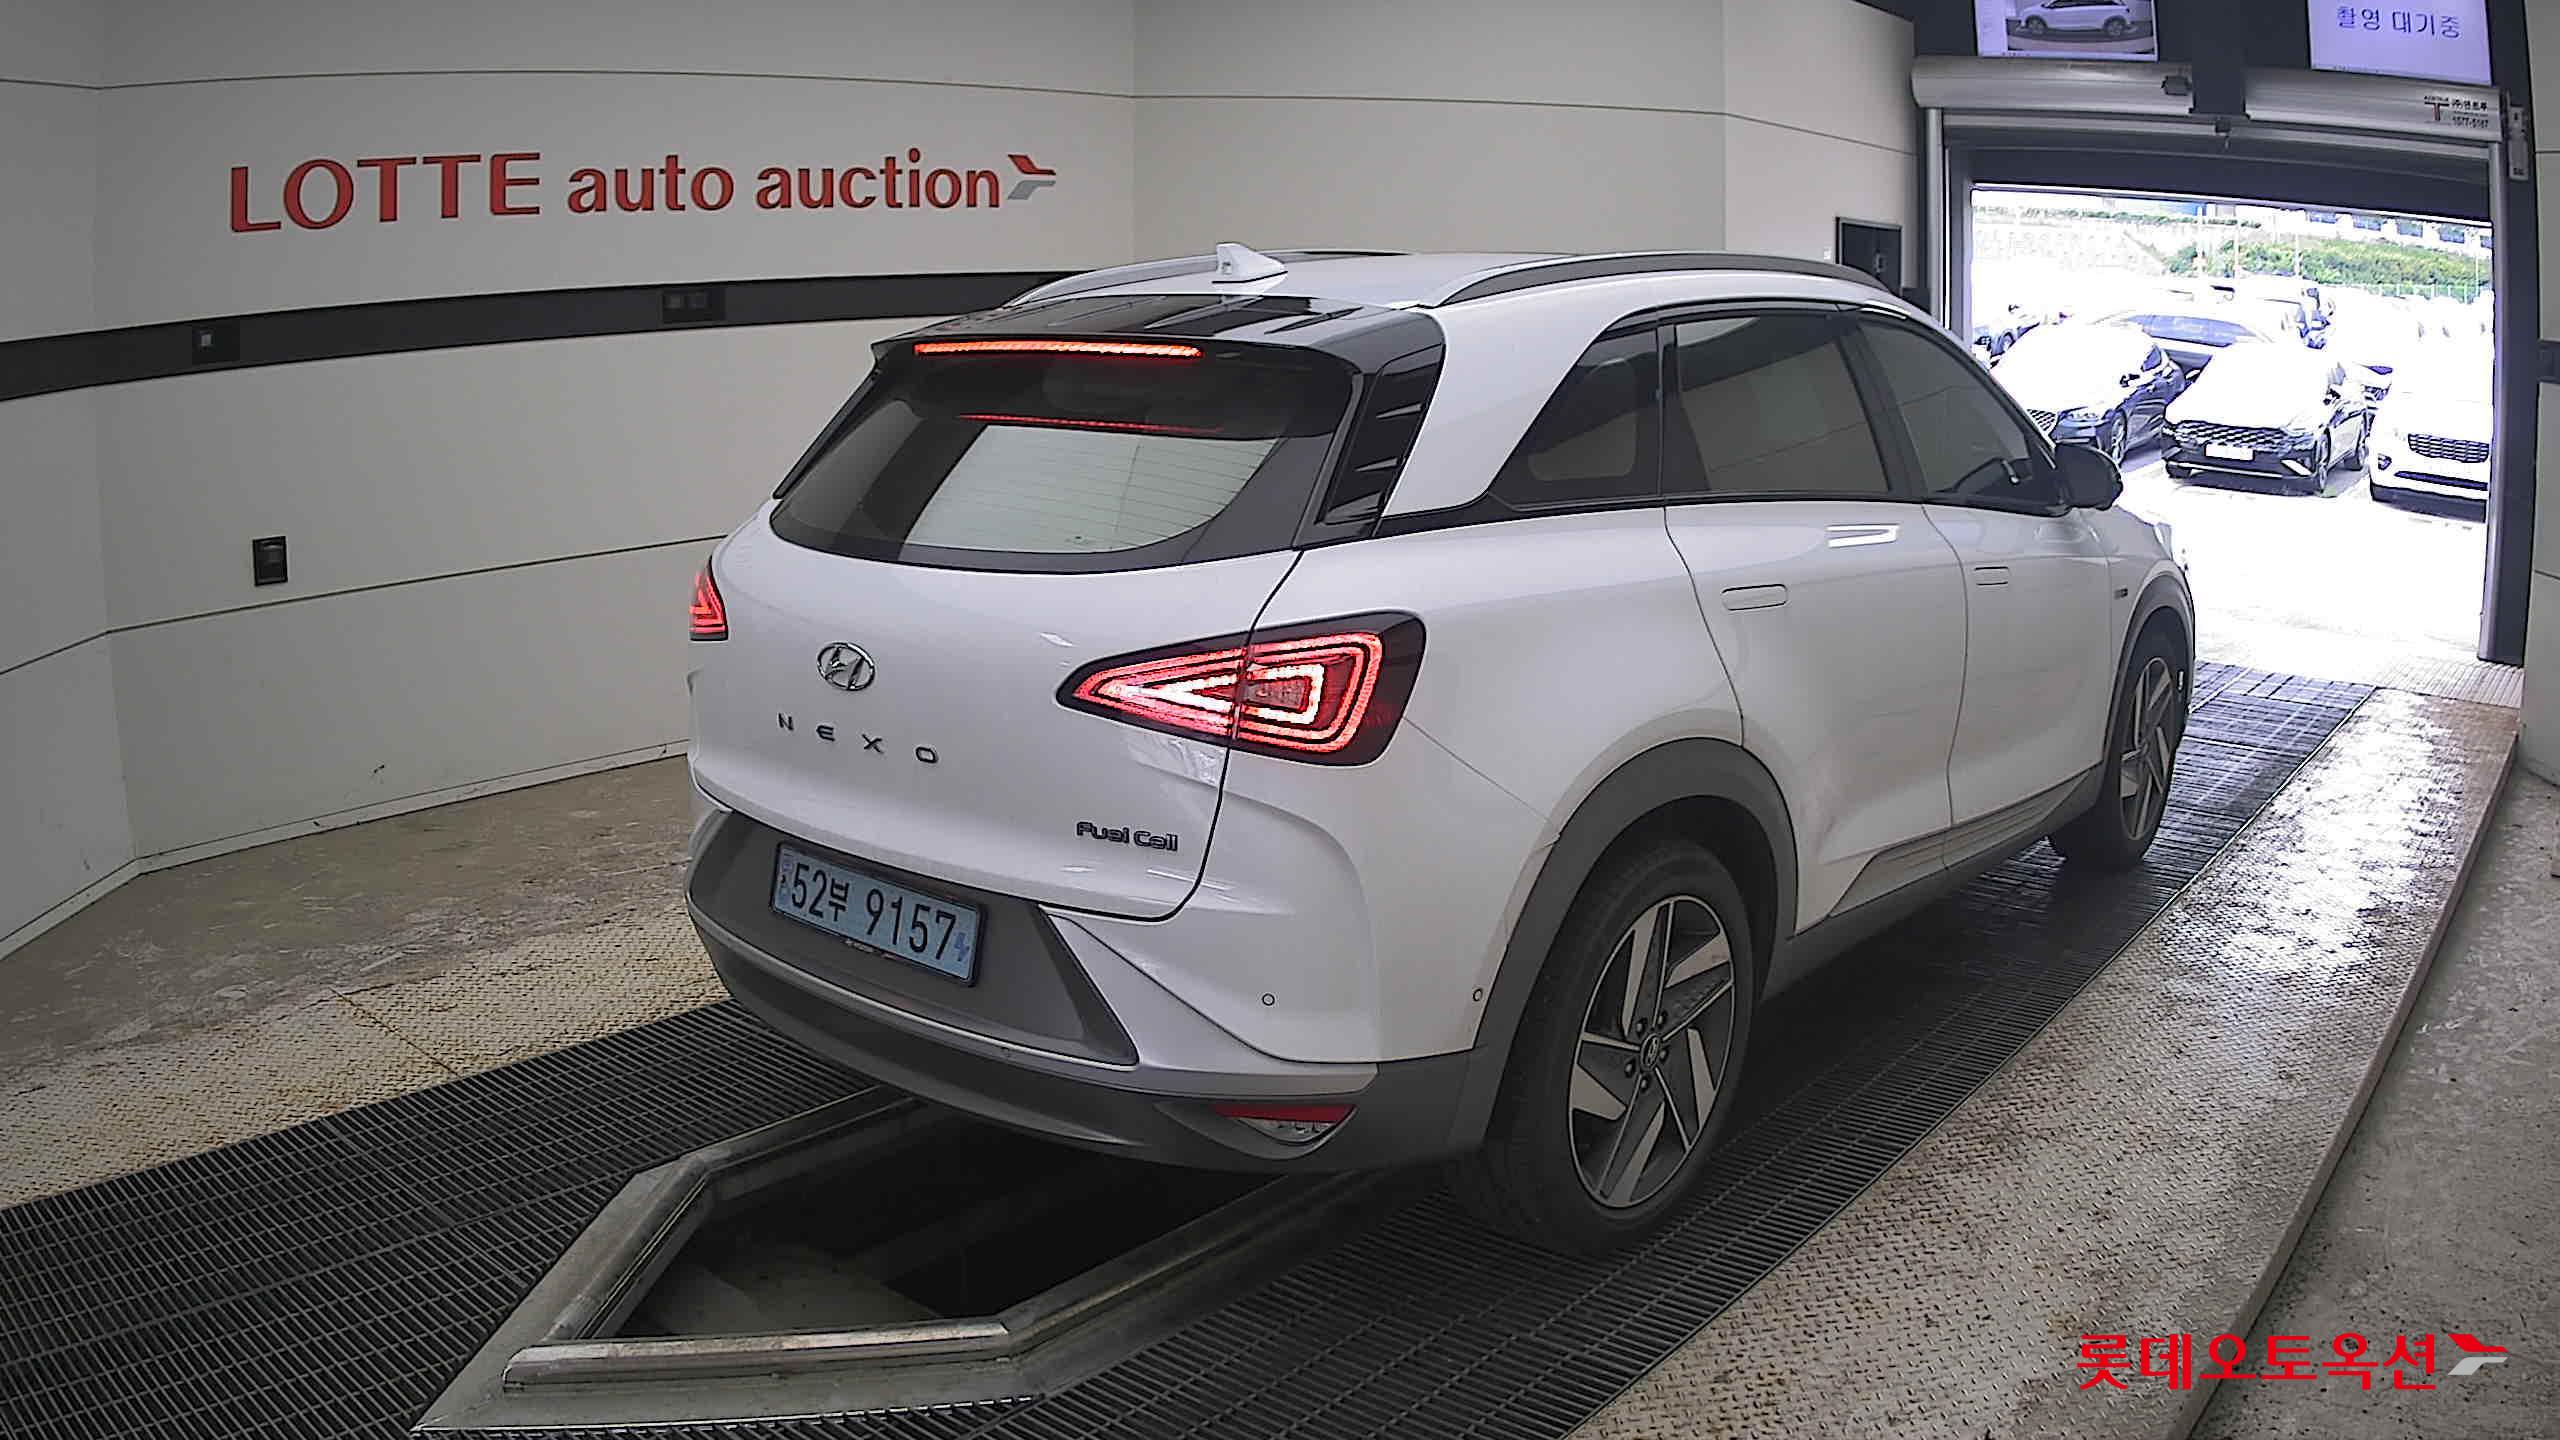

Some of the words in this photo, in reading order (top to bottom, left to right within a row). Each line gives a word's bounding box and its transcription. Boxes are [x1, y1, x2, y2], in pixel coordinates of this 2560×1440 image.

[2337, 6, 2381, 31] 촬영
[2391, 10, 2461, 39] 대기중
[230, 152, 541, 233] LOTTE
[567, 154, 734, 213] auto
[755, 147, 1001, 209] auction
[777, 712, 939, 764] NEXO
[1076, 821, 1130, 844] Fuel
[1133, 830, 1179, 852] Cell
[791, 863, 850, 923] 52부
[866, 888, 957, 960] 9157
